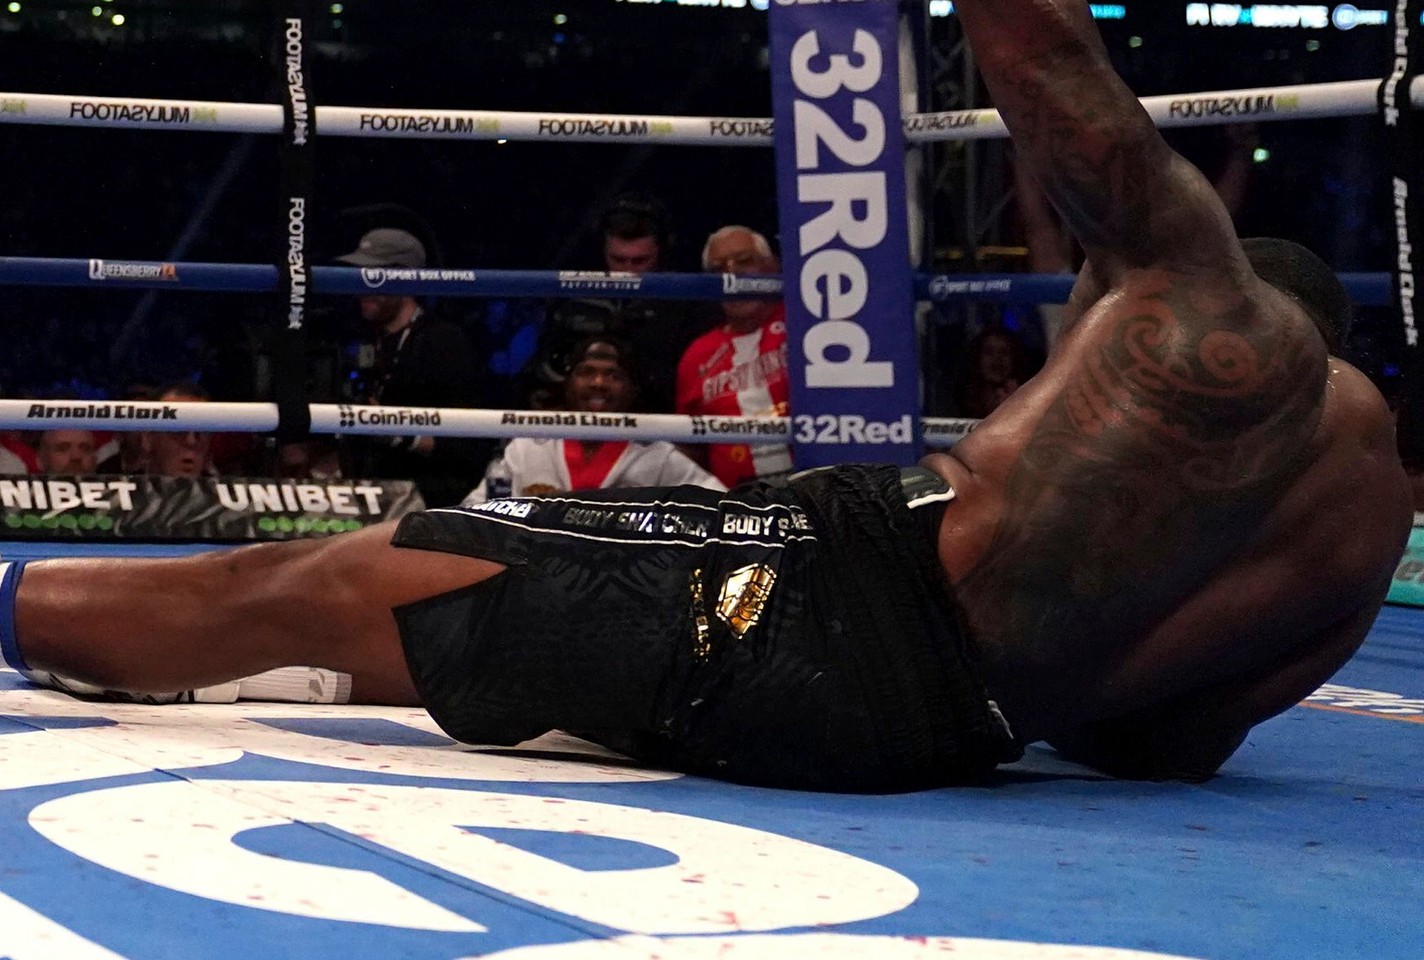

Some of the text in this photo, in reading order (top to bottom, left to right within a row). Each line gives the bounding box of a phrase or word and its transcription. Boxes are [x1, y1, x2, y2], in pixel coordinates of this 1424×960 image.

[70, 102, 190, 123] FOOTASYLUM
[360, 113, 474, 134] FOOTASYLUM
[538, 118, 648, 137] FOOTASYLUM
[790, 28, 894, 389] 32Red
[1392, 175, 1413, 272] Arnold
[287, 197, 306, 304] FOOTASYLUM
[27, 404, 178, 421] Arnold Clark
[358, 408, 442, 427] CoinField
[709, 418, 787, 436] CoinField
[795, 415, 913, 445] 32Red
[217, 482, 382, 515] UNIBET
[723, 513, 774, 537] BODY
